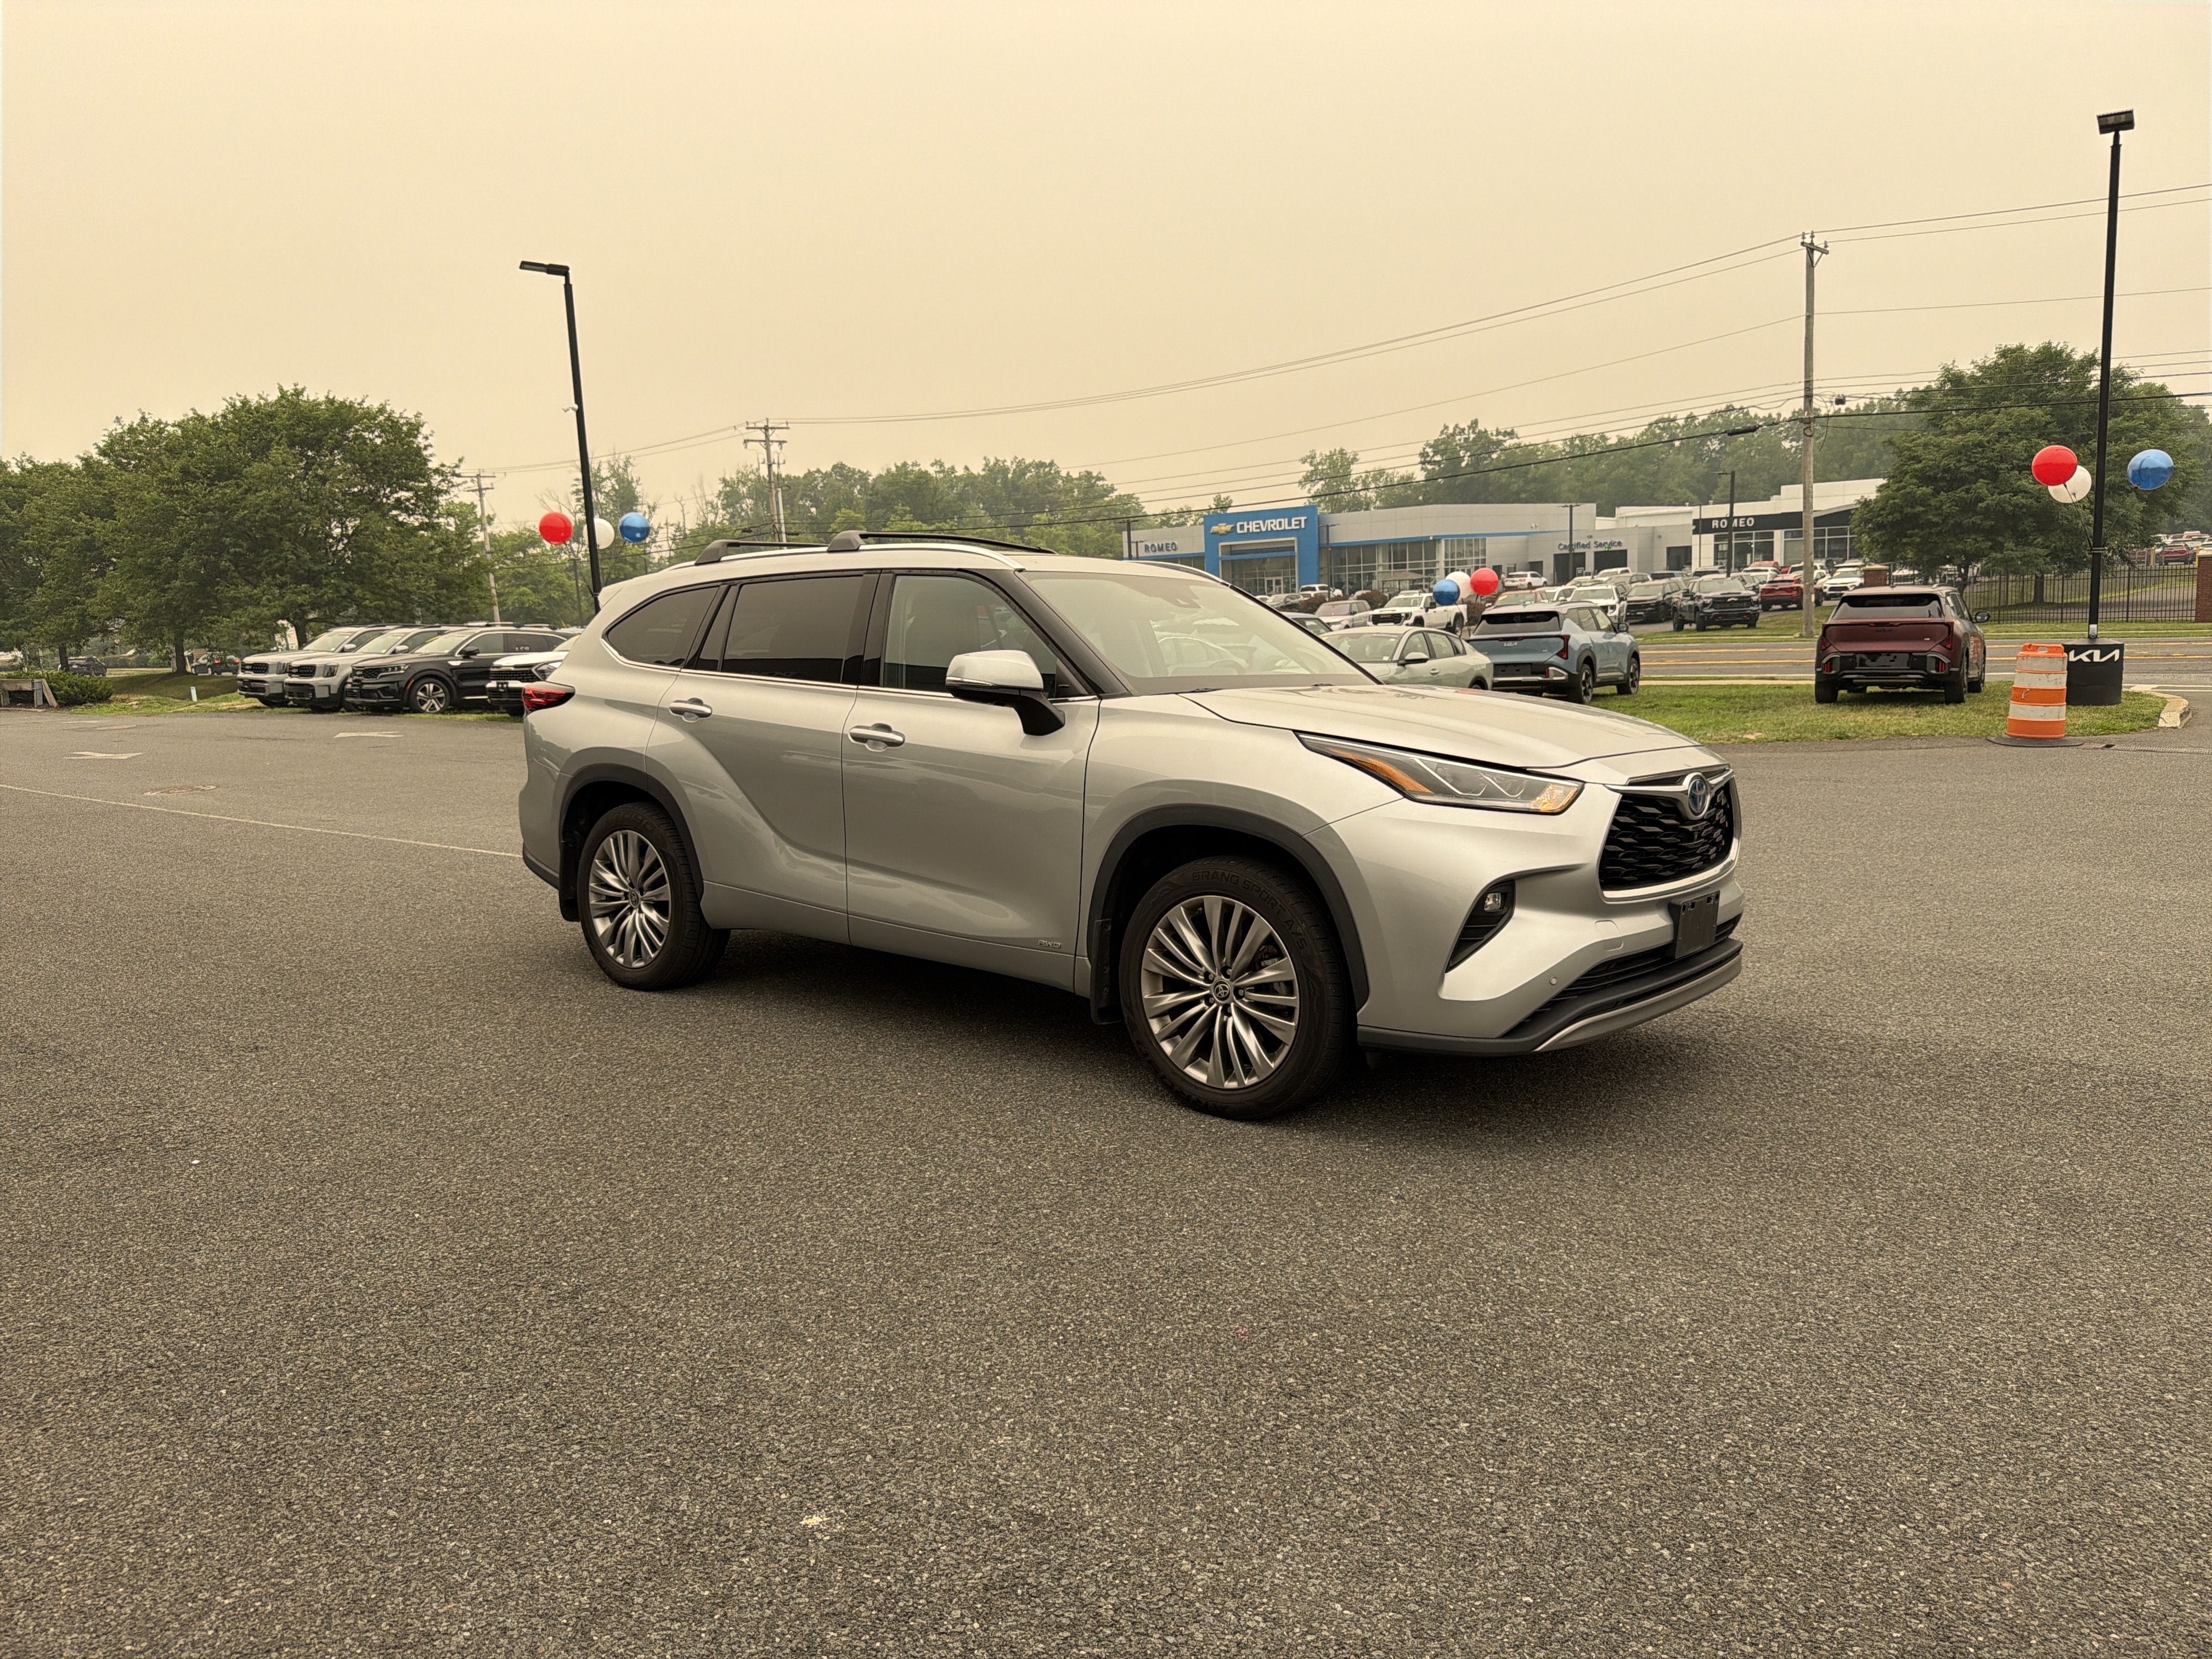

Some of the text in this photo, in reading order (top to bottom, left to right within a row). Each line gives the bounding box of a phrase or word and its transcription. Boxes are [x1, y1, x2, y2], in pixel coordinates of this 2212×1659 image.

[1236, 516, 1307, 534] CHEVROLET
[1144, 541, 1177, 554] ROMEO
[1593, 540, 1622, 548] Service
[2069, 649, 2120, 662] KIA
[1192, 870, 1308, 950] GRAND SPORT A/S
[1038, 940, 1062, 948] AWD
